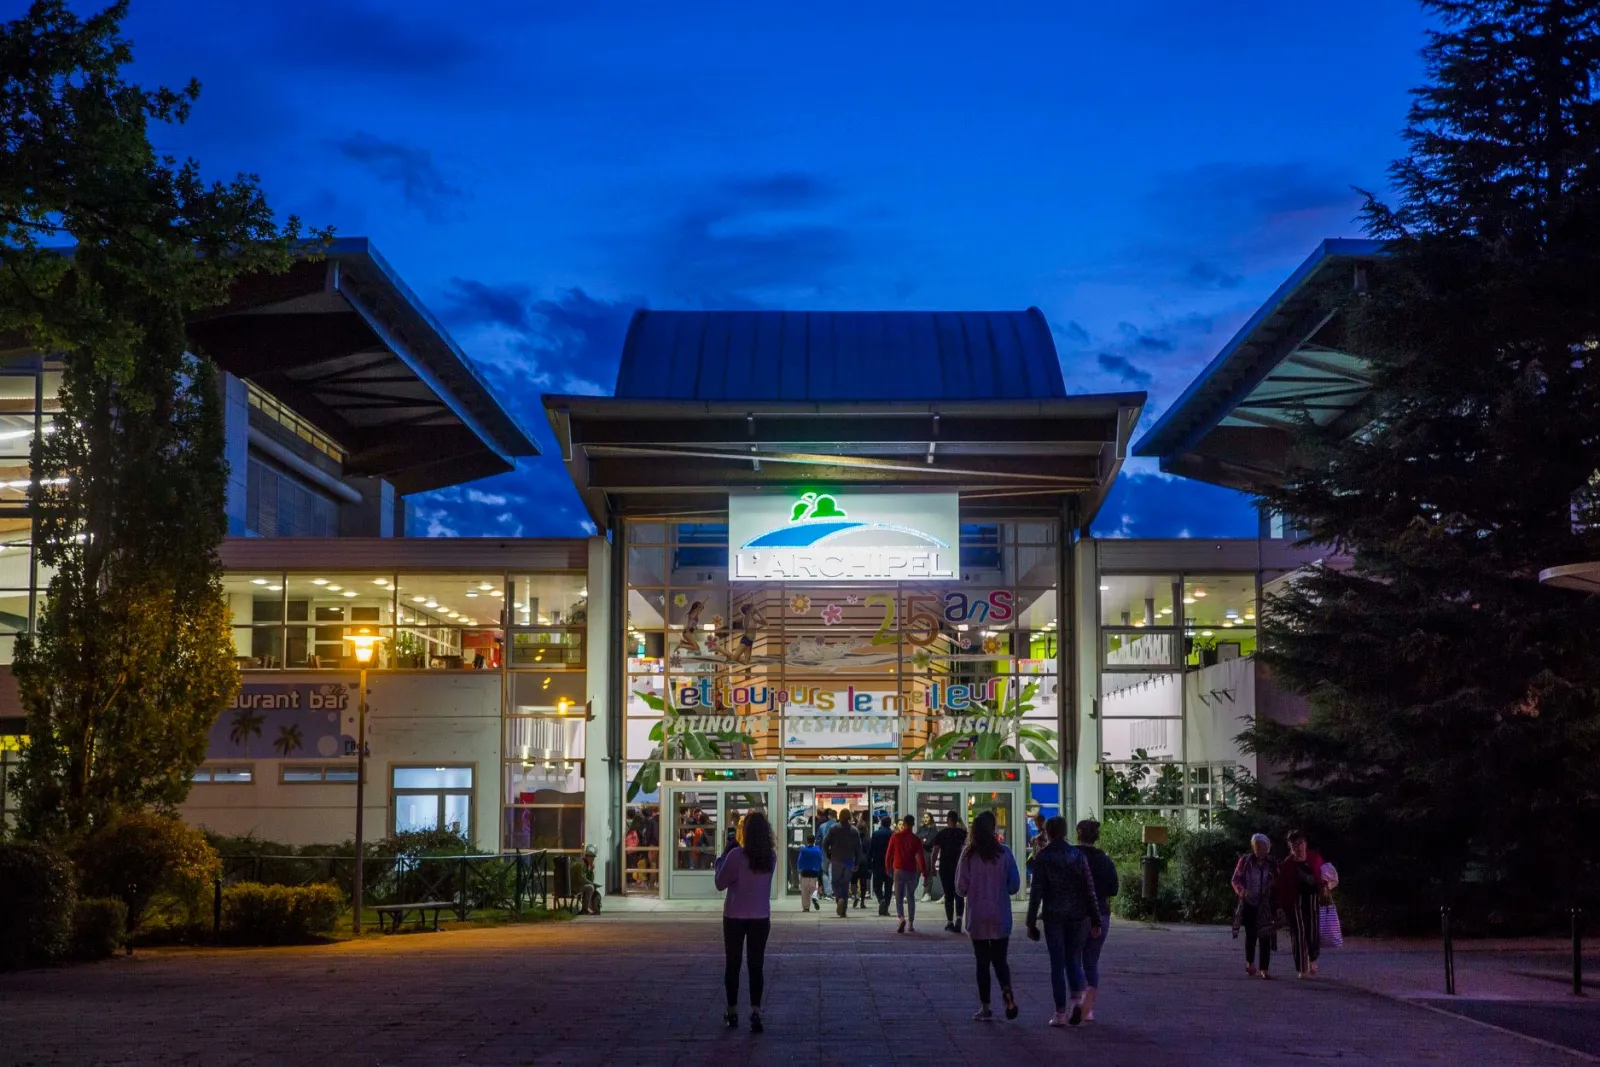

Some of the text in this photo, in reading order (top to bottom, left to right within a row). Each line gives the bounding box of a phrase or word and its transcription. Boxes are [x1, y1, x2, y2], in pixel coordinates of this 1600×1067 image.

[736, 553, 953, 577] L'ARCHIPEL
[864, 590, 1013, 646] 25 ans
[309, 690, 349, 710] bar
[680, 676, 1002, 713] et toujours le meilleur
[661, 714, 1022, 736] PATINOIRE RESTAURANT PISCINE
